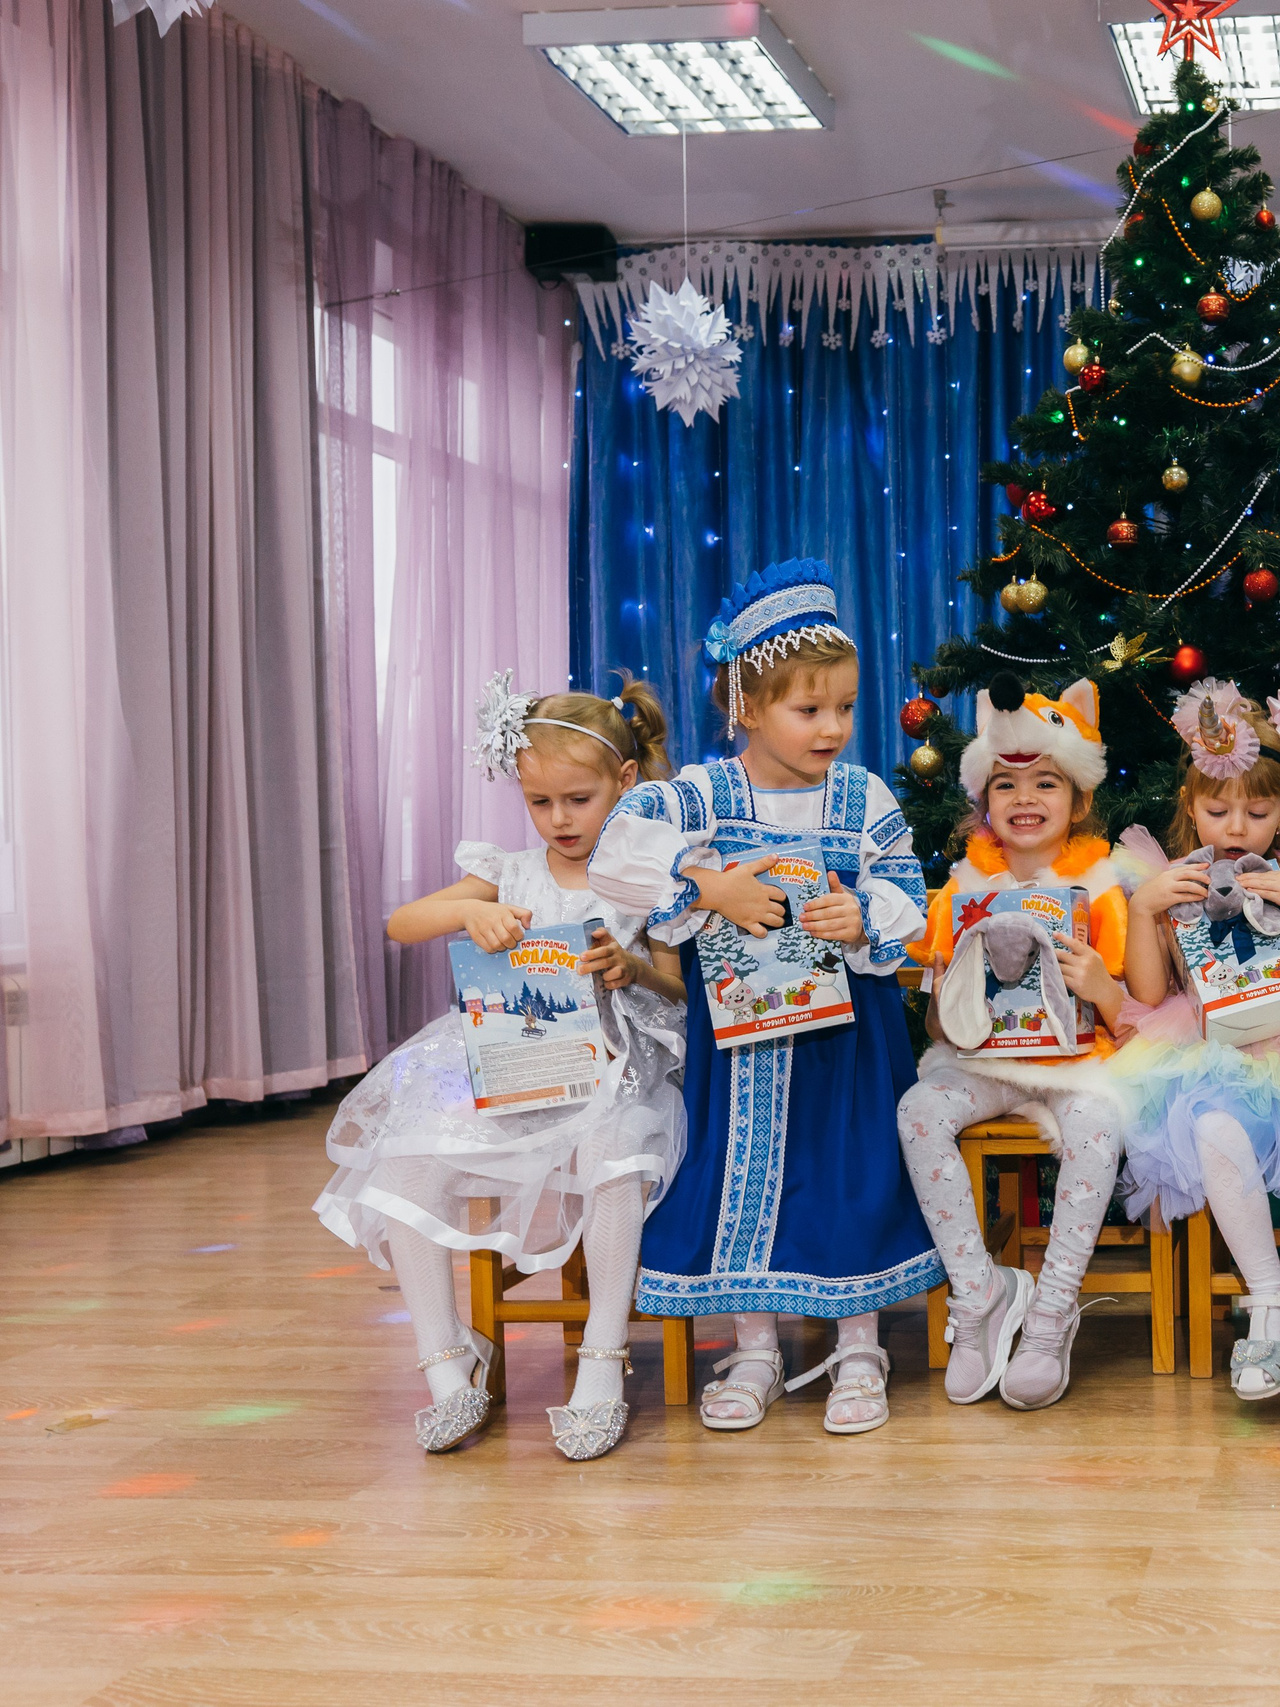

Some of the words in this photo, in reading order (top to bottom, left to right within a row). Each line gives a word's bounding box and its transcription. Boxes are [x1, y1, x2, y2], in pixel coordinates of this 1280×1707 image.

[769, 863, 821, 882] ПОДАРОК
[1022, 900, 1066, 920] ПОДАРОК
[510, 948, 579, 969] ПОДАРОК
